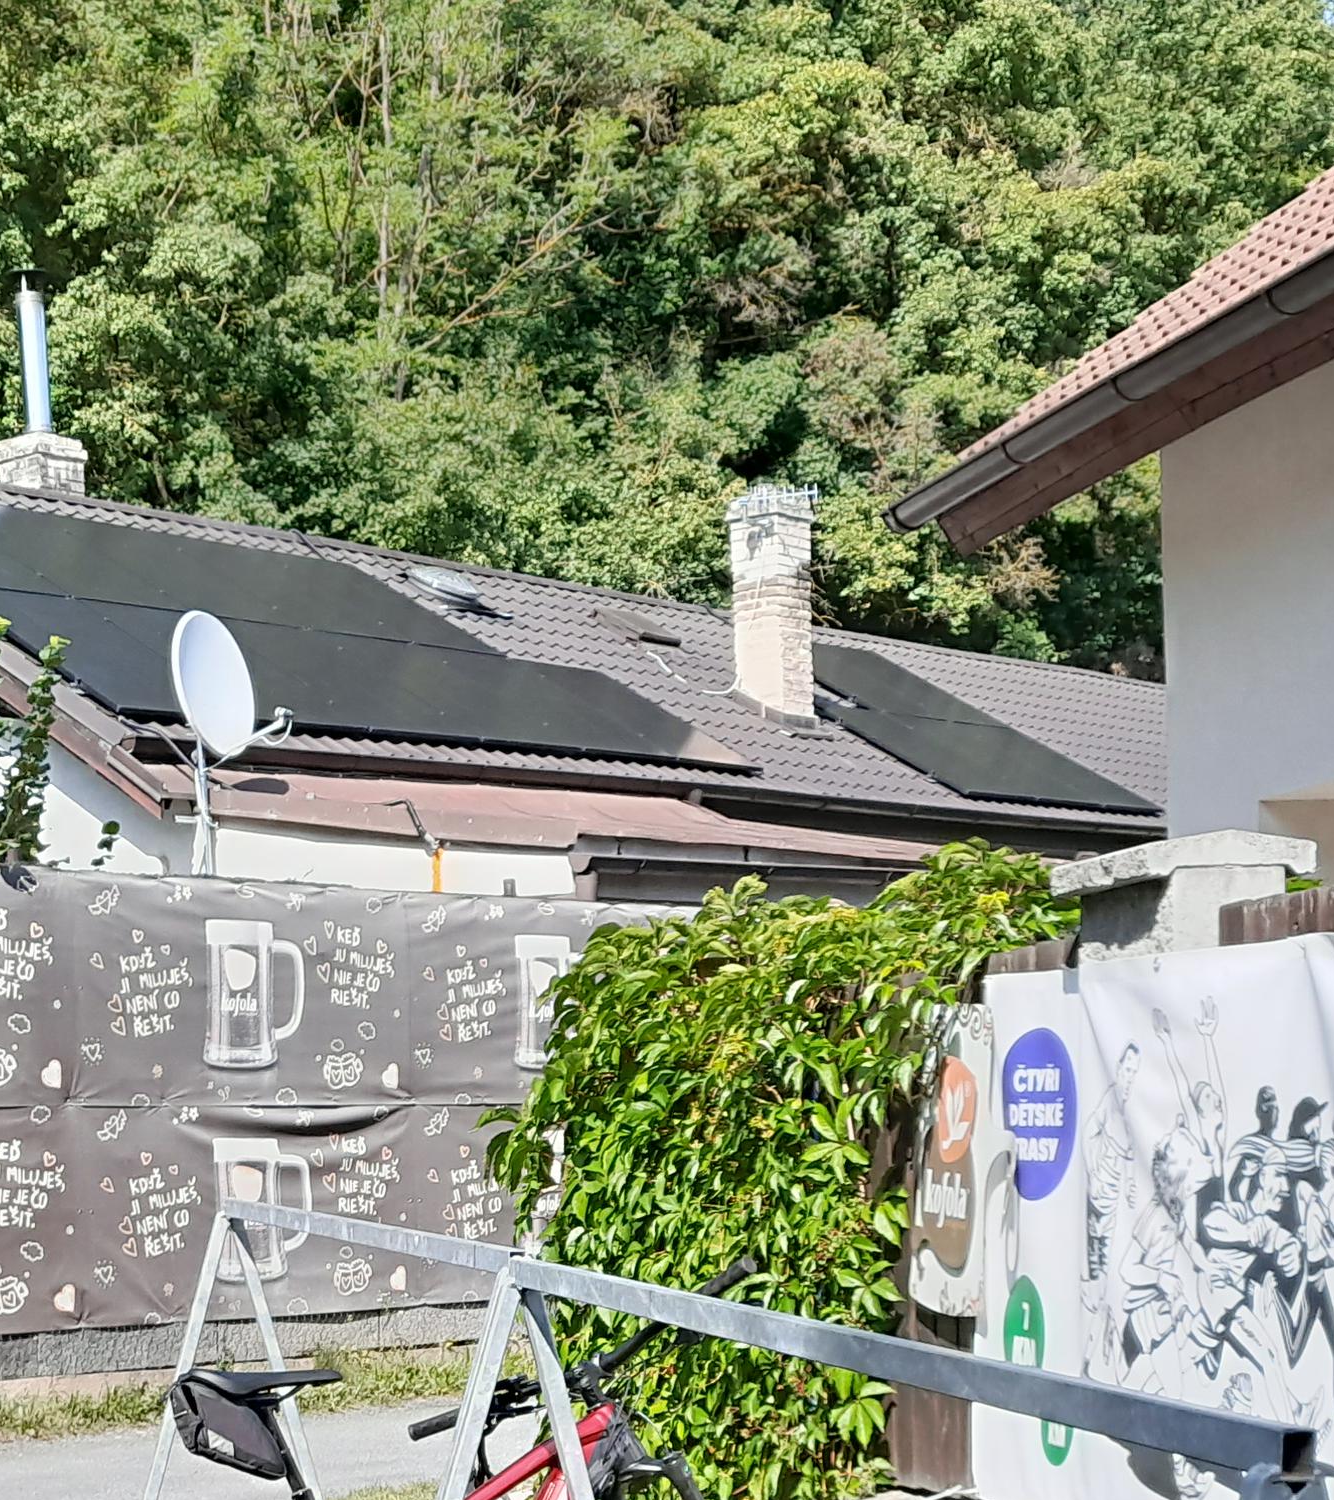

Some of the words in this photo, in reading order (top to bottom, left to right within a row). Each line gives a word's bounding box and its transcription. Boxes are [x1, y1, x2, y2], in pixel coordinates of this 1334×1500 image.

[120, 976, 130, 994] JI
[163, 990, 180, 1009] CO
[221, 992, 257, 1017] kofola
[1013, 1063, 1060, 1093] ČTYŘI
[1008, 1097, 1064, 1127] DĚTSKÉ
[130, 1200, 140, 1217] JI
[924, 1168, 967, 1228] kofola
[174, 1209, 189, 1228] CO
